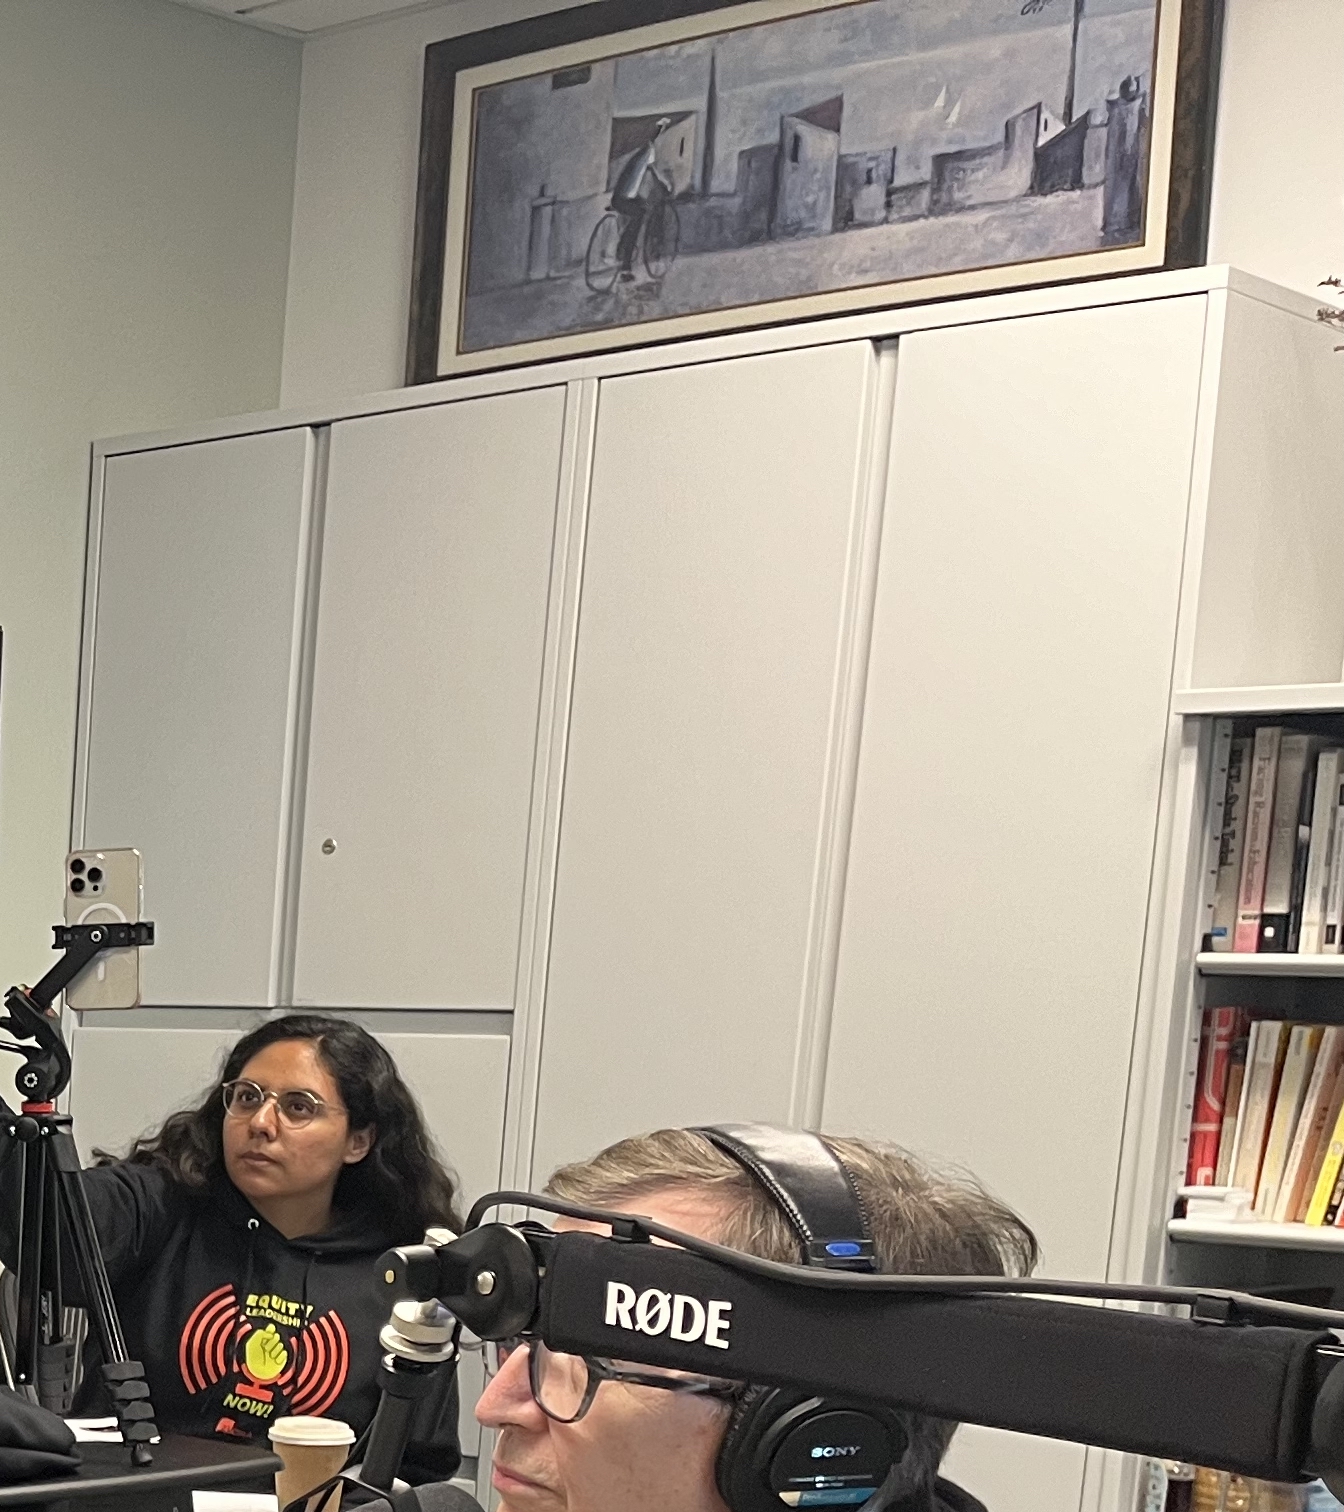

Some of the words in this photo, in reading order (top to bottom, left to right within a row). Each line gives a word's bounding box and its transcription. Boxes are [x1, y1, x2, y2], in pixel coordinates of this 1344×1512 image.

[245, 1292, 314, 1319] EQUITY
[245, 1306, 309, 1328] LEADERSHI
[604, 1280, 733, 1350] RØDE
[222, 1393, 274, 1418] NOW!
[811, 1445, 861, 1458] SONY
